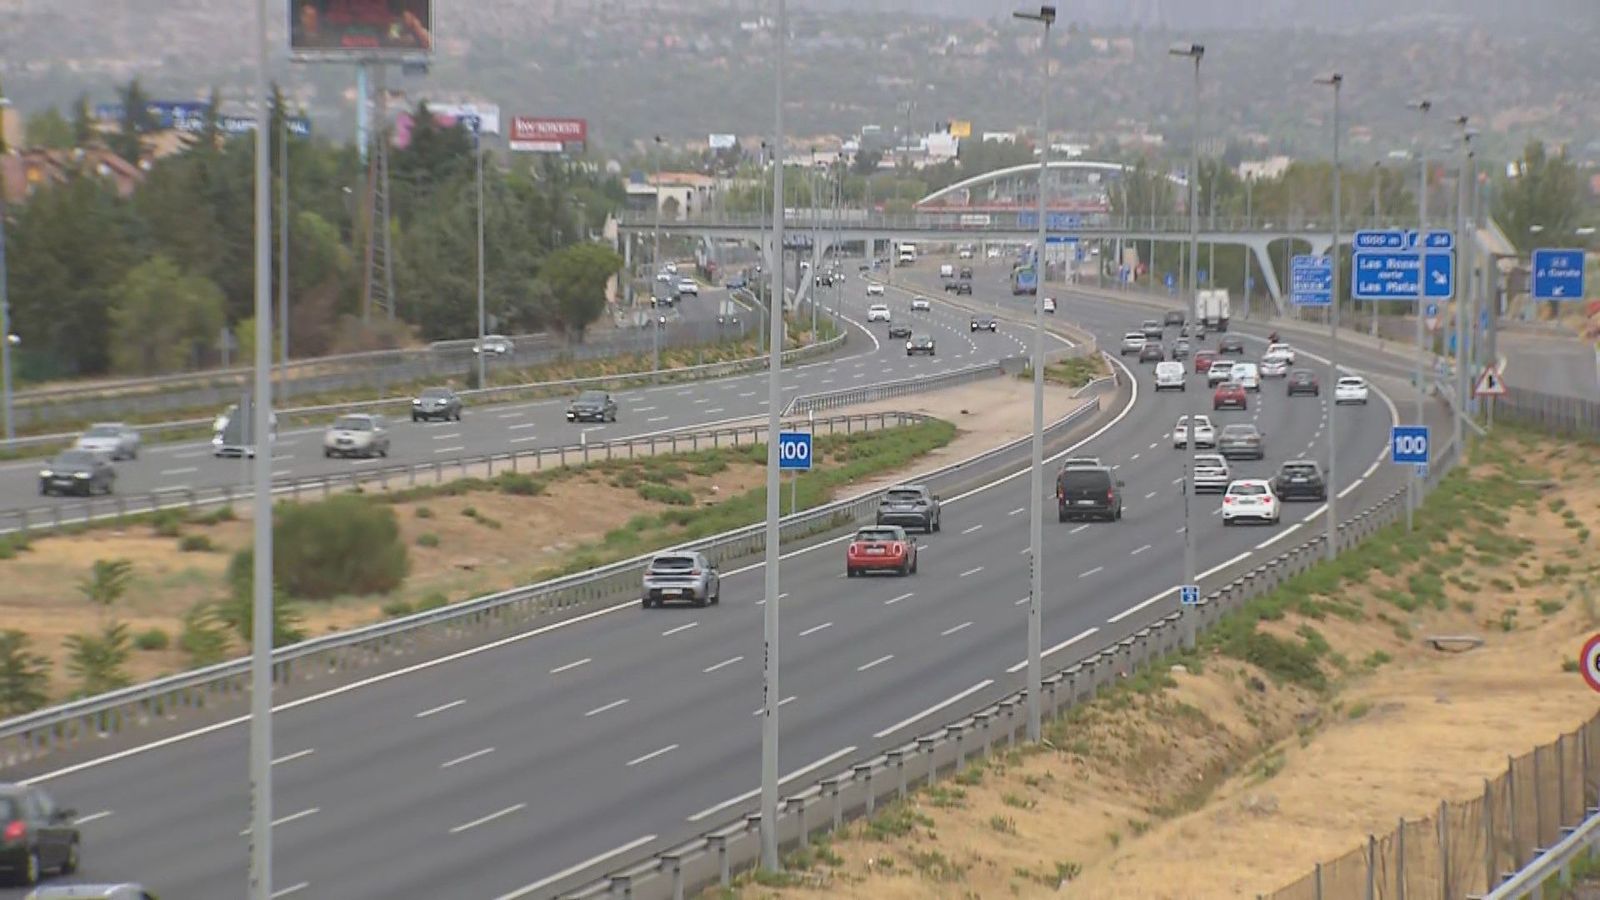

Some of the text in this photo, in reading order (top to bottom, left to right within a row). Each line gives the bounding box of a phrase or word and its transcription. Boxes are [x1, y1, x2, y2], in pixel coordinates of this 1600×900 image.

[1360, 258, 1382, 270] Las
[1360, 281, 1382, 292] Las
[780, 441, 808, 460] 100
[1396, 436, 1426, 454] 100
